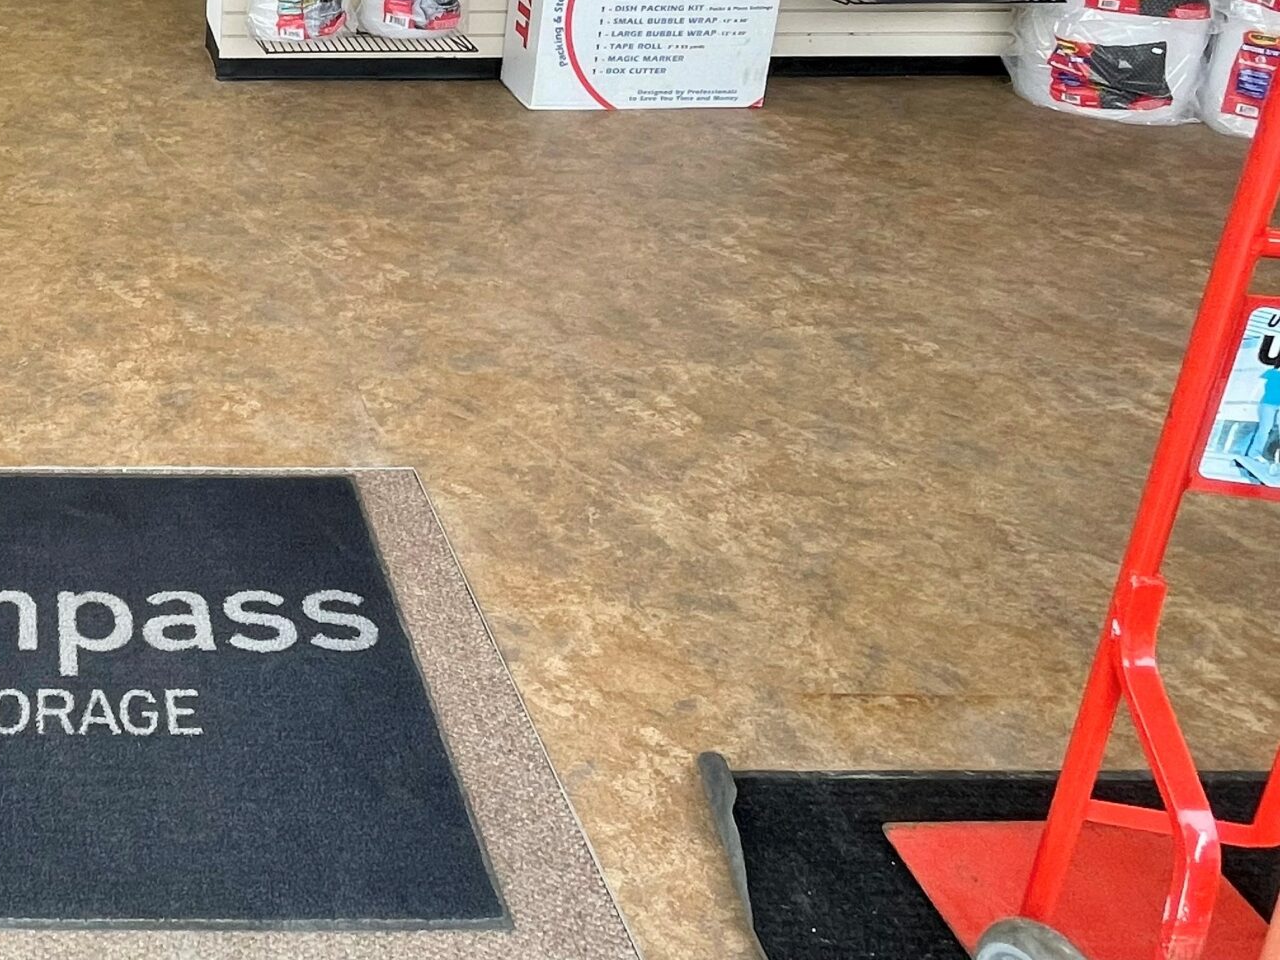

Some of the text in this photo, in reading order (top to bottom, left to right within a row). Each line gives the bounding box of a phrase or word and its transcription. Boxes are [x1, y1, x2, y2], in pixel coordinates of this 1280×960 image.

[688, 4, 705, 12] KIT
[553, 14, 562, 24] &
[613, 17, 644, 25] SMALL
[647, 17, 685, 25] BUBBLE
[611, 30, 643, 38] LARGE
[554, 26, 568, 68] Packing
